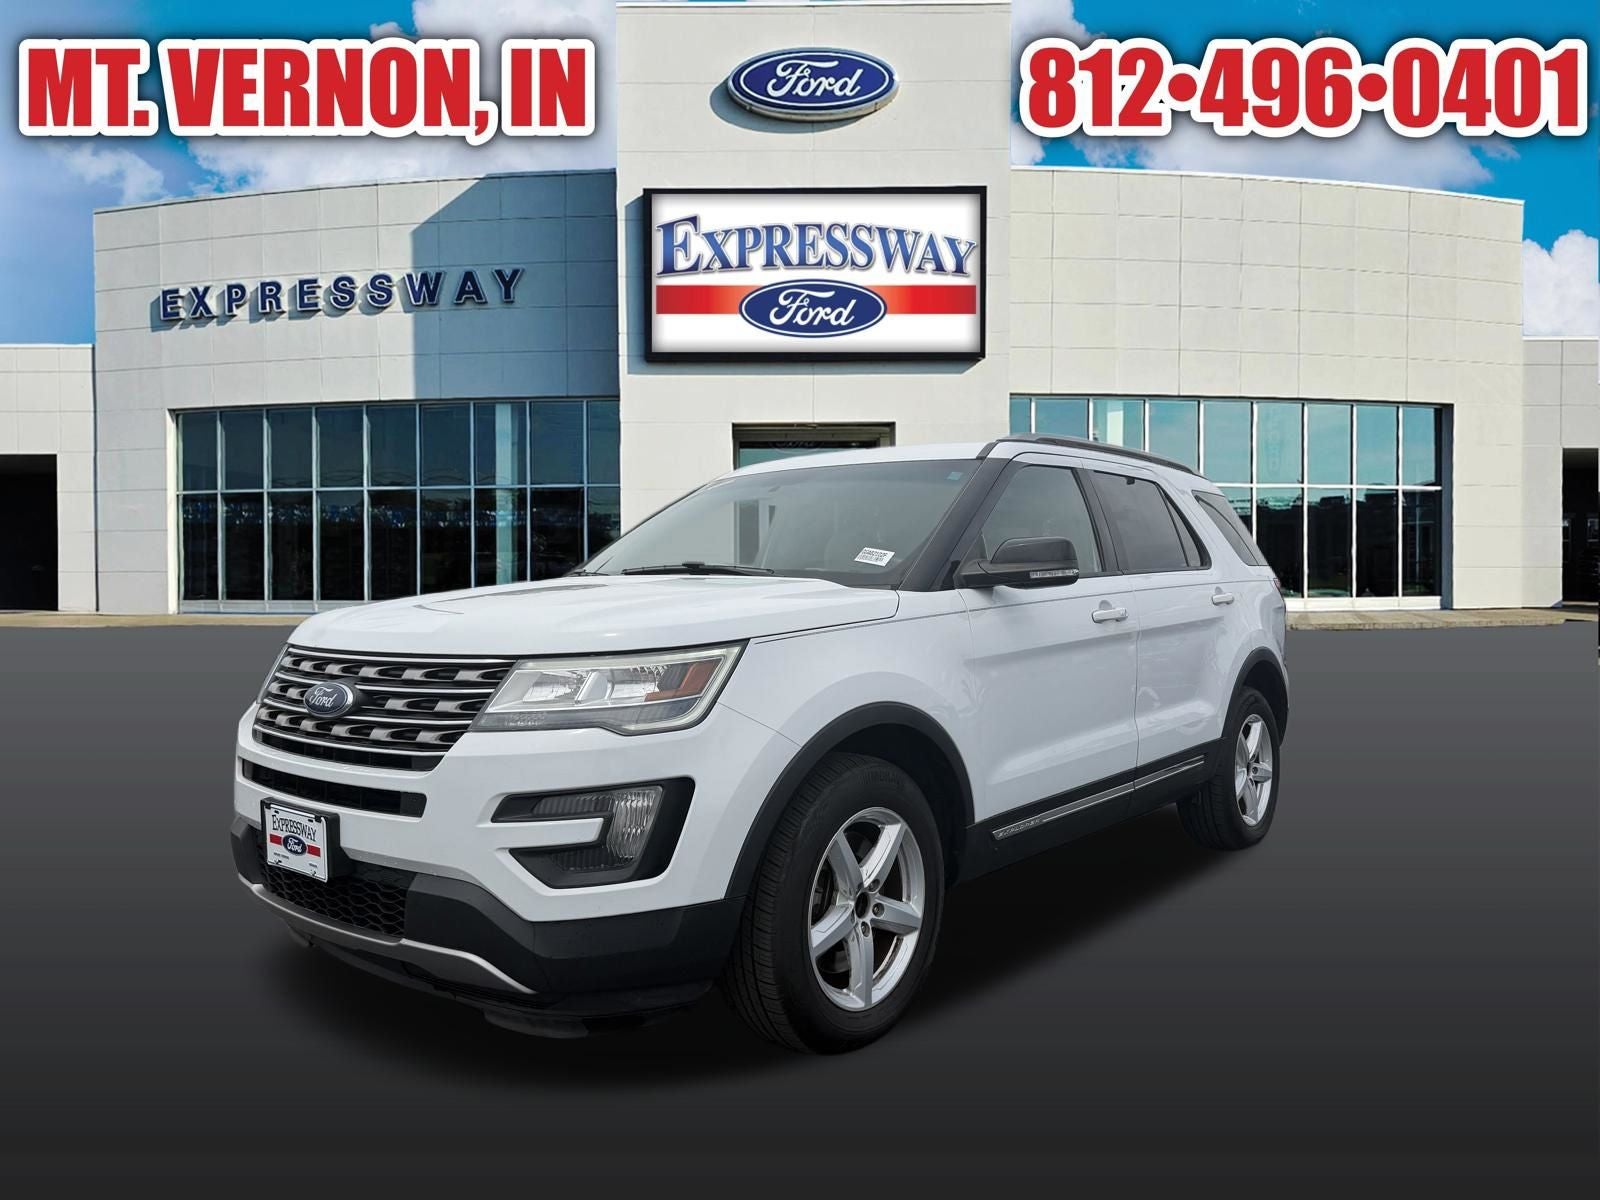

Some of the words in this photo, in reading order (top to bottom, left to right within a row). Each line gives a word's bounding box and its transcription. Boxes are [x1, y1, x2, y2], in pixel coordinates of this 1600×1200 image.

[766, 59, 863, 97] Ford
[655, 213, 978, 278] EXPRESSWAY
[160, 268, 525, 322] EXPRESSWAY
[769, 288, 857, 327] Ford
[308, 686, 338, 707] Ford
[271, 814, 317, 842] EXPRESSWAY
[287, 837, 303, 853] Ford
